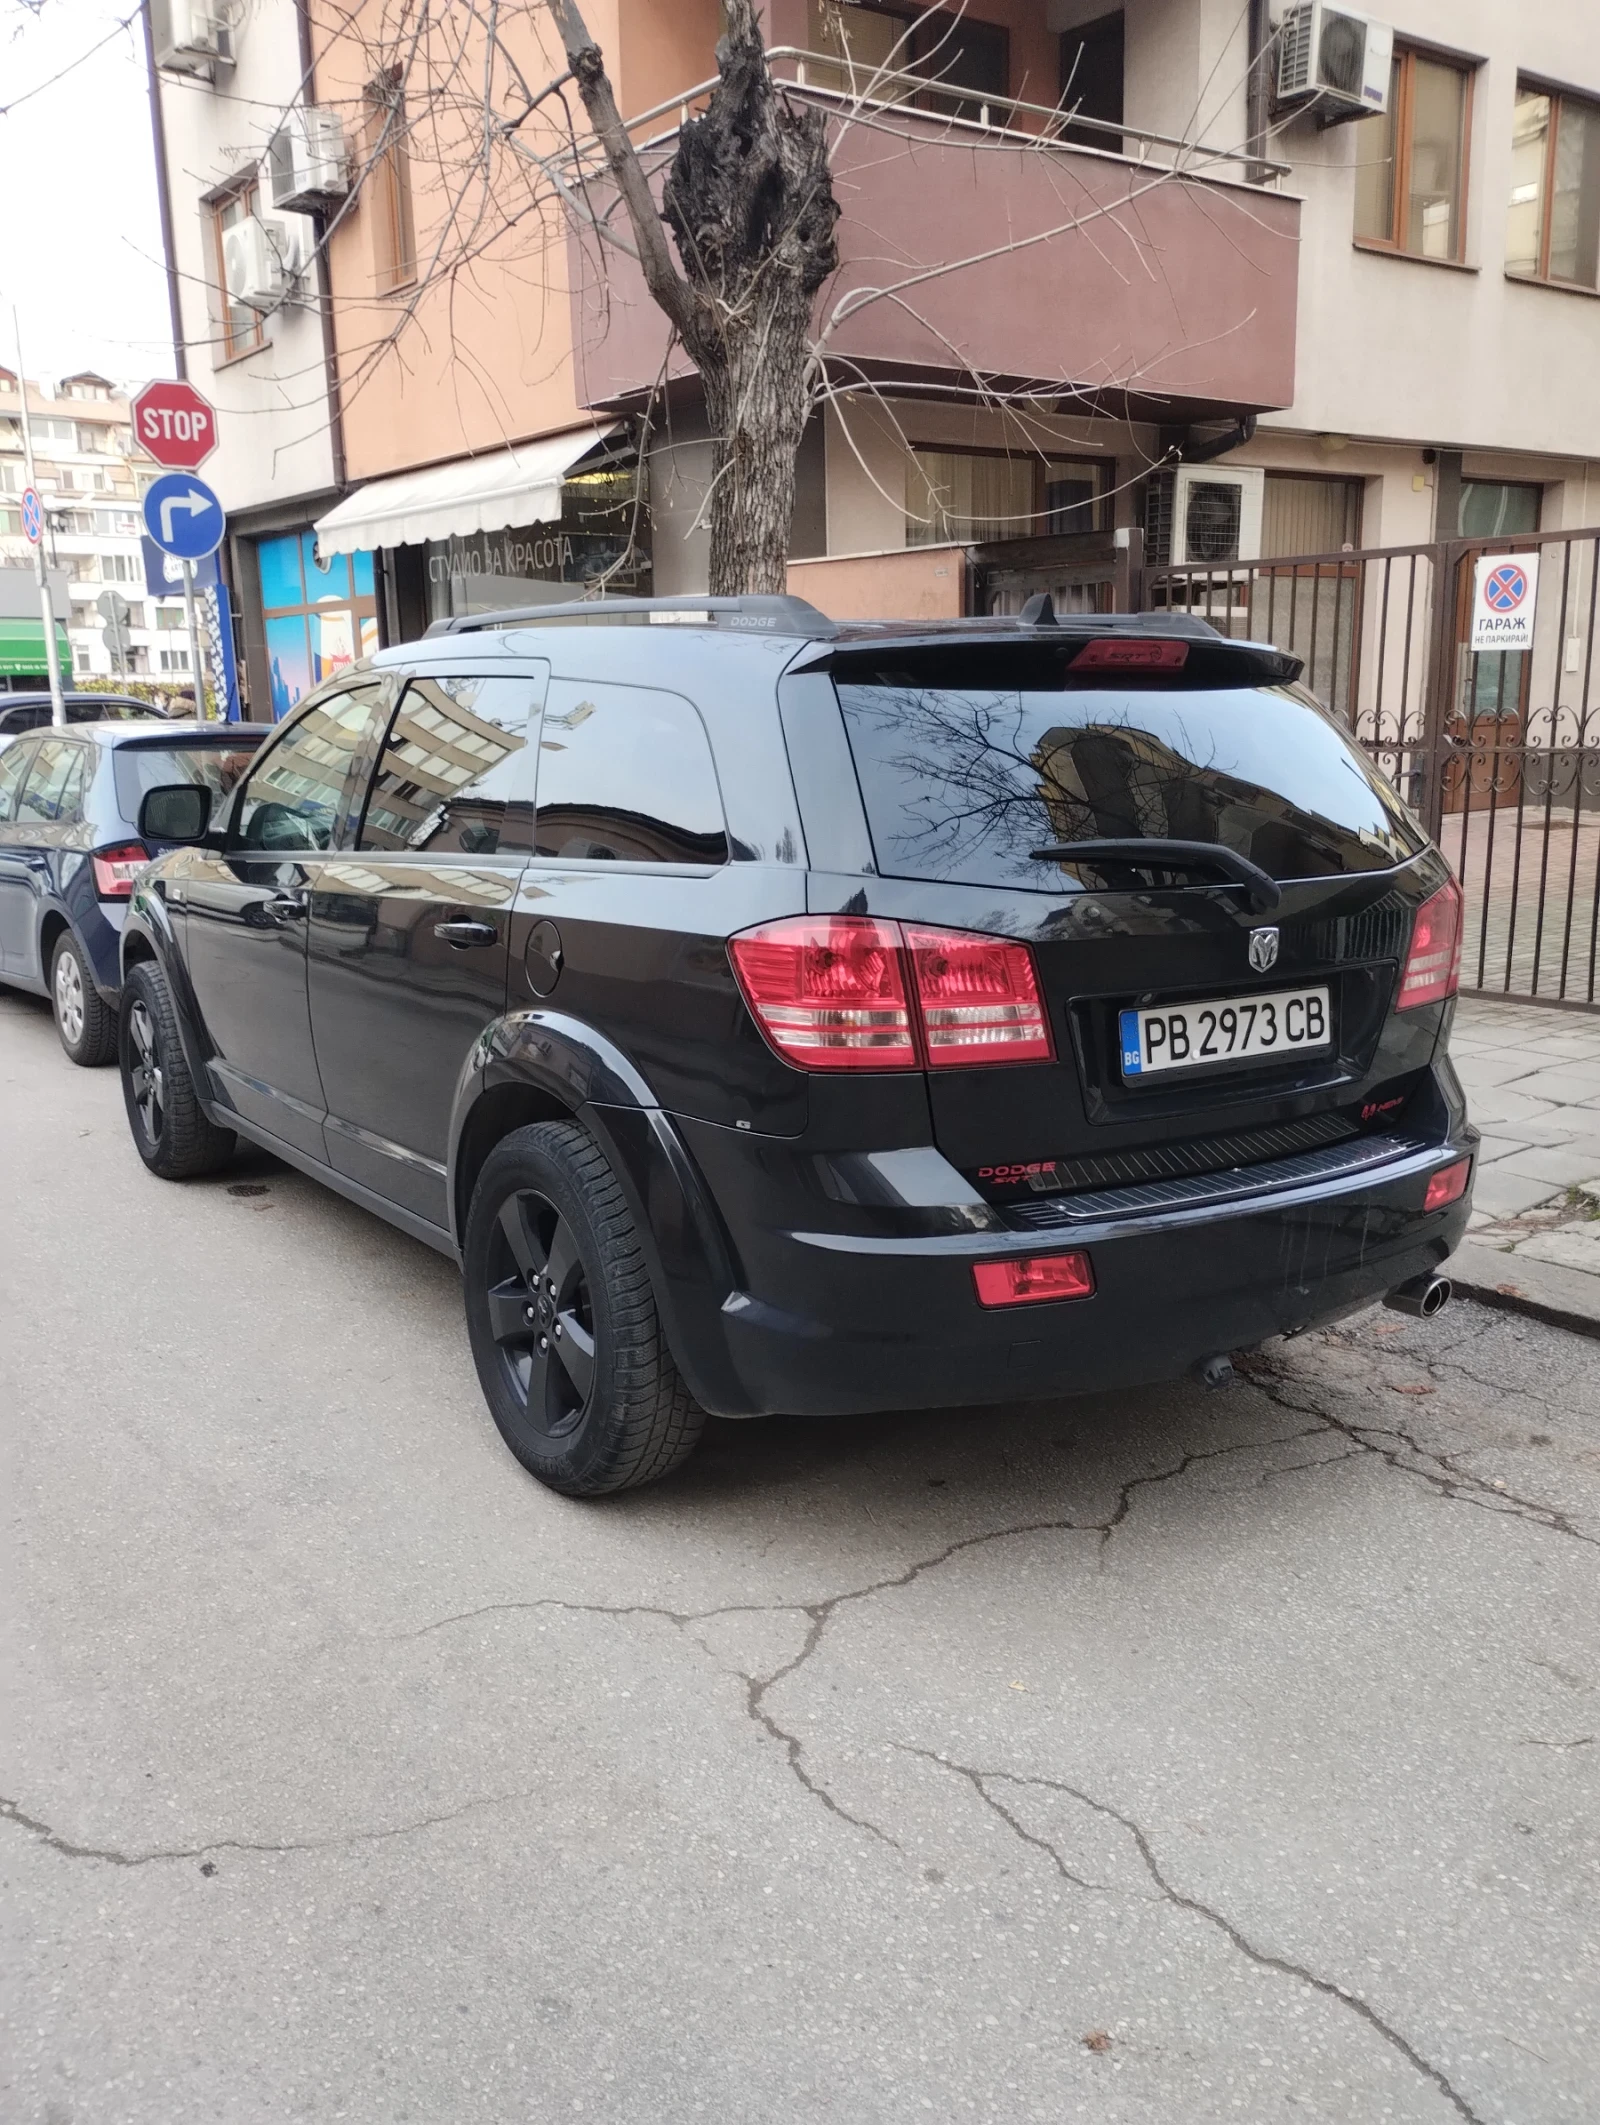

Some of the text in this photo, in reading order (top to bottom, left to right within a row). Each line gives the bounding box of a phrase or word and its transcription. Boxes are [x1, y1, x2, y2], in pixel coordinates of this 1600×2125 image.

[142, 407, 207, 442] STOP
[429, 550, 481, 586] СТУДИО
[505, 536, 574, 573] КРАСОТА
[730, 617, 777, 627] DODGE
[1479, 617, 1526, 631] ГАРАЖ
[1475, 633, 1528, 644] НЕ ПАРКИРАЙ!
[1145, 996, 1325, 1064] PB 2973 CB
[1124, 1051, 1139, 1066] BG
[978, 1162, 1056, 1177] DODGE
